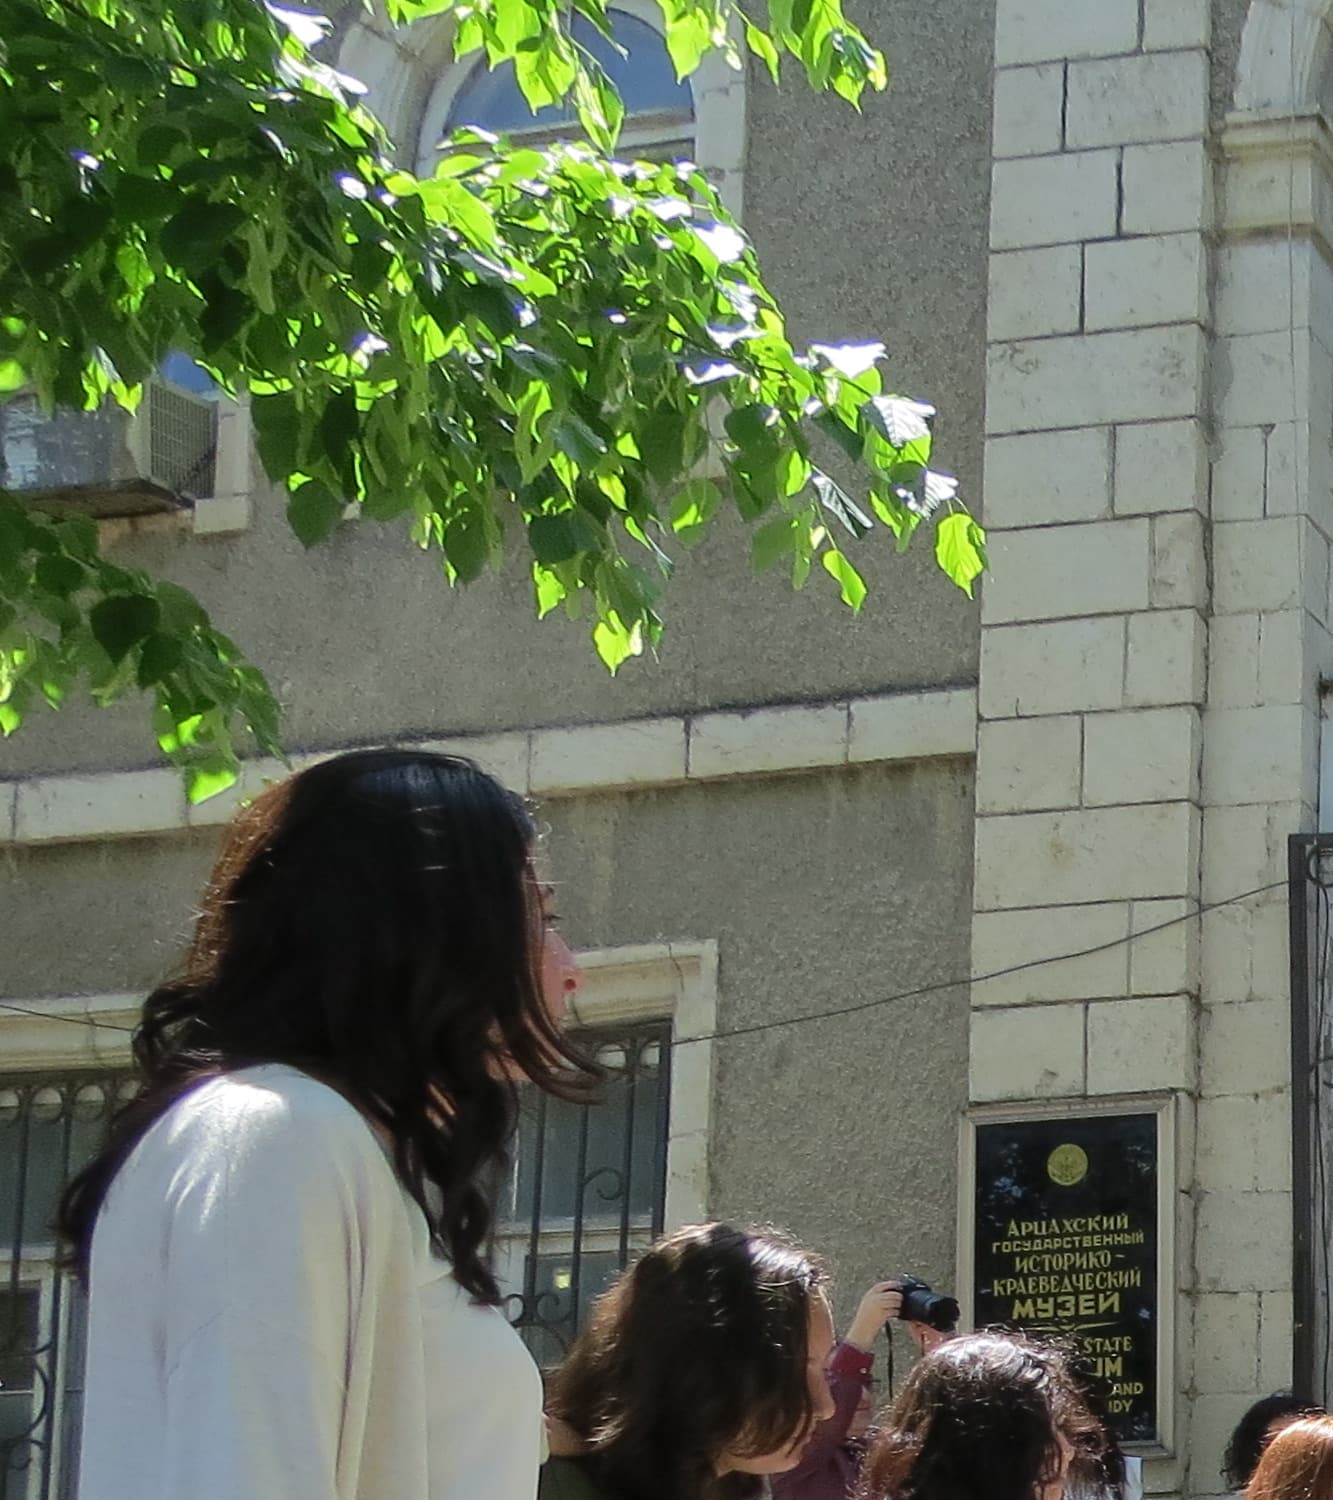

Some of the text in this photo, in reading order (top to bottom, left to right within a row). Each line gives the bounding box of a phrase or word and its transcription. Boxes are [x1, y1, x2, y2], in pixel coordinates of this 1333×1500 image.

[1007, 1213, 1129, 1238] АРЦАХСКИЙ
[992, 1230, 1145, 1254] ГОСУДАРСТВЕННЫЙ
[993, 1267, 1142, 1297] КРАЕВЕДЧЕСКИЙ
[1012, 1291, 1121, 1320] МУЗЕЙ
[1083, 1336, 1133, 1354] STATE
